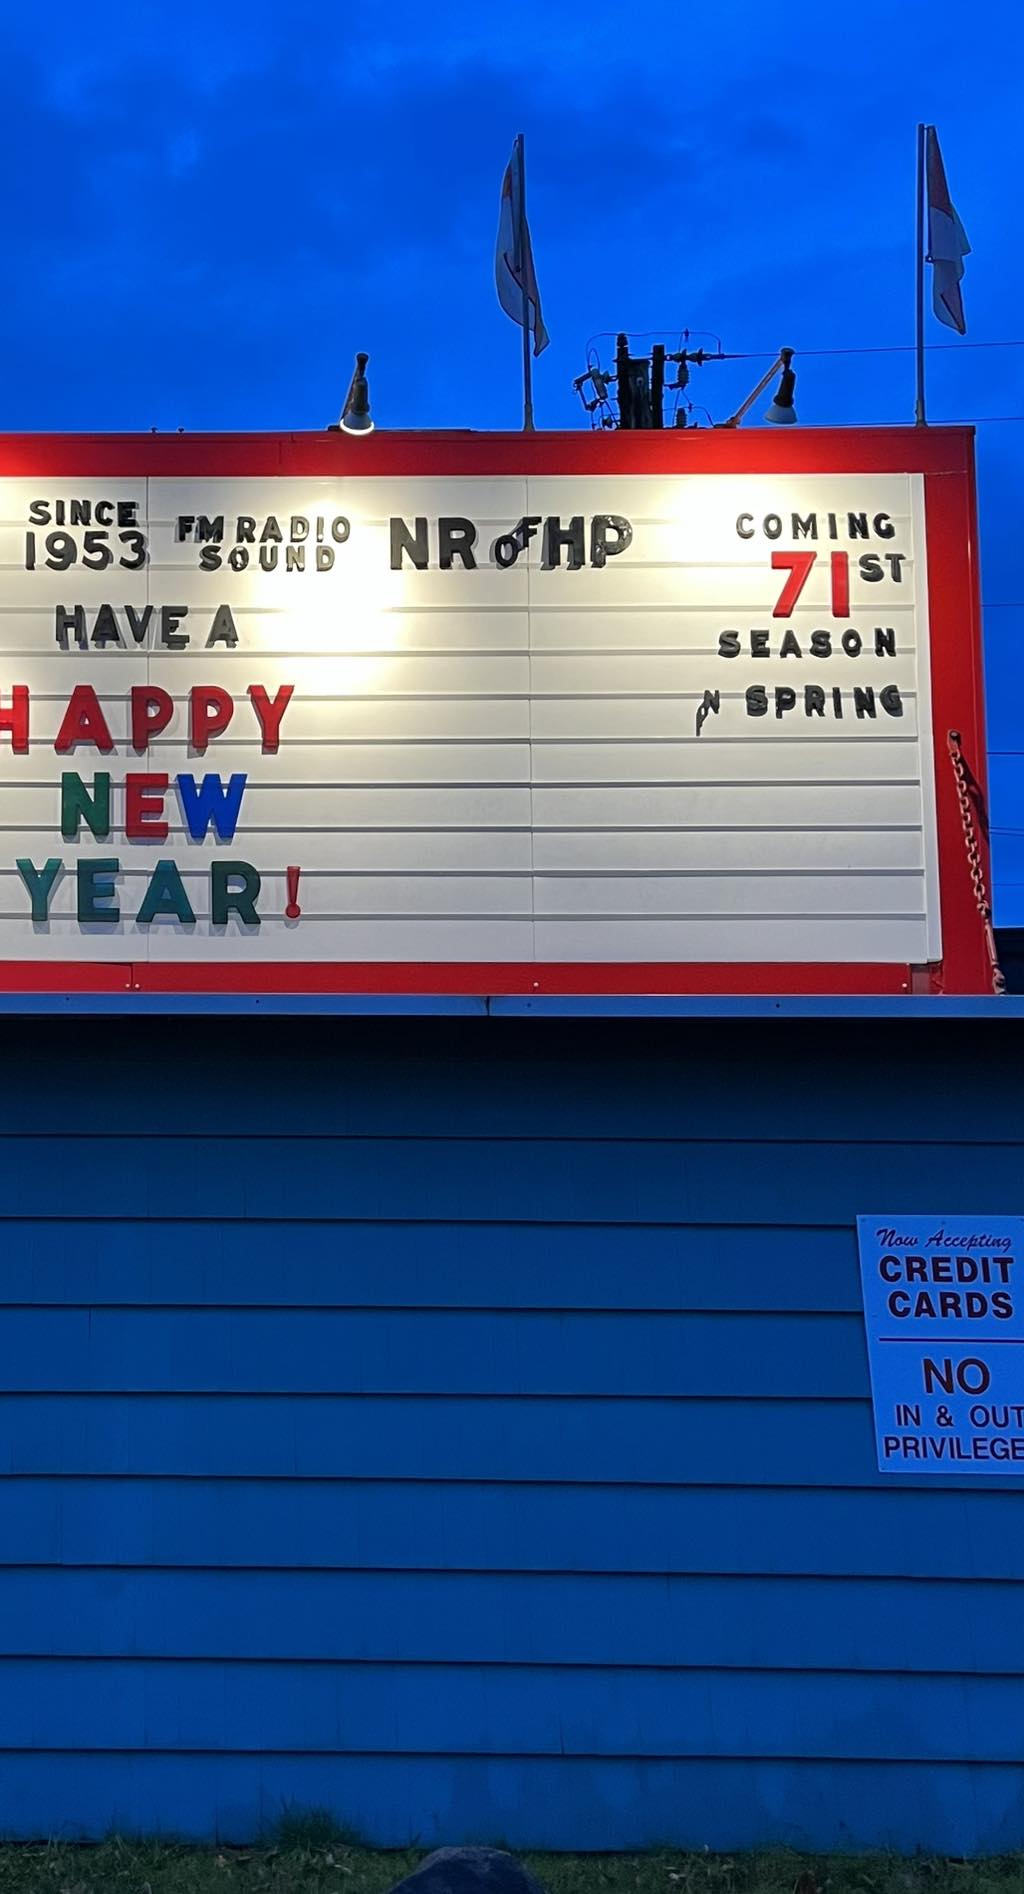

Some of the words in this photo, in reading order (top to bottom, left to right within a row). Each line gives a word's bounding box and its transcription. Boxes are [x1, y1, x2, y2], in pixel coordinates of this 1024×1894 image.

[28, 499, 140, 528] SINCE
[735, 512, 896, 540] COMING
[177, 515, 225, 544] FM
[235, 515, 351, 544] RADIO
[389, 517, 477, 570] NR
[540, 514, 633, 571] HP
[25, 530, 150, 572] 1953
[198, 545, 336, 573] SOUND
[55, 603, 190, 650] HAVE
[205, 603, 239, 649] A
[717, 627, 897, 659] SEASON
[745, 684, 904, 720] SPRING
[60, 772, 247, 841] NEW
[16, 858, 301, 926] YEAR!
[876, 1227, 919, 1248] Now
[925, 1229, 1013, 1254] Accepting
[879, 1255, 1014, 1284] CREDIT
[888, 1290, 1014, 1320] CARDS
[923, 1358, 990, 1395] NO
[895, 1404, 921, 1427] IN
[936, 1405, 954, 1428] &
[969, 1404, 1024, 1429] OUT
